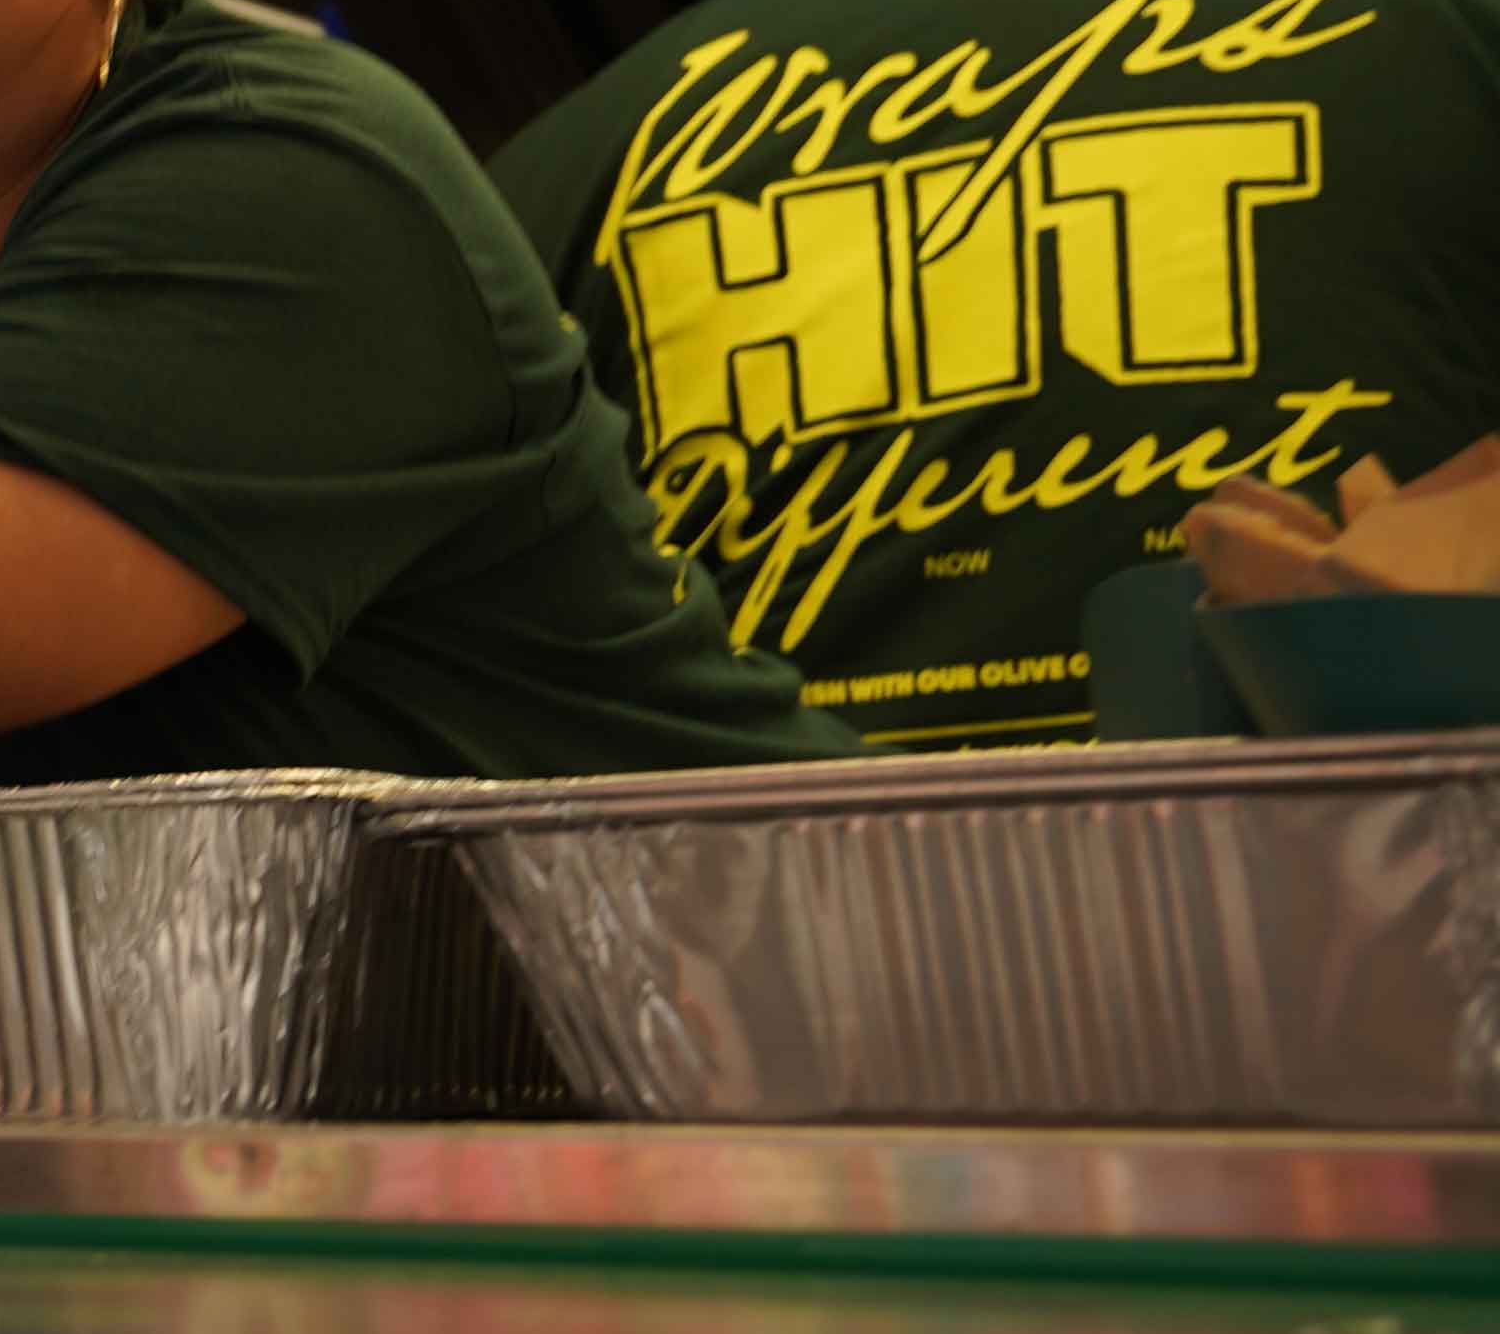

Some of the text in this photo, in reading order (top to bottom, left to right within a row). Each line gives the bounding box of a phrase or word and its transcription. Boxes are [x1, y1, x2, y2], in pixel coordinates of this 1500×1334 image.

[610, 101, 1321, 467] HIT
[925, 550, 990, 578] NOW
[849, 670, 915, 703] WITH
[917, 663, 977, 695] OUR
[979, 654, 1065, 688] OLIVE
